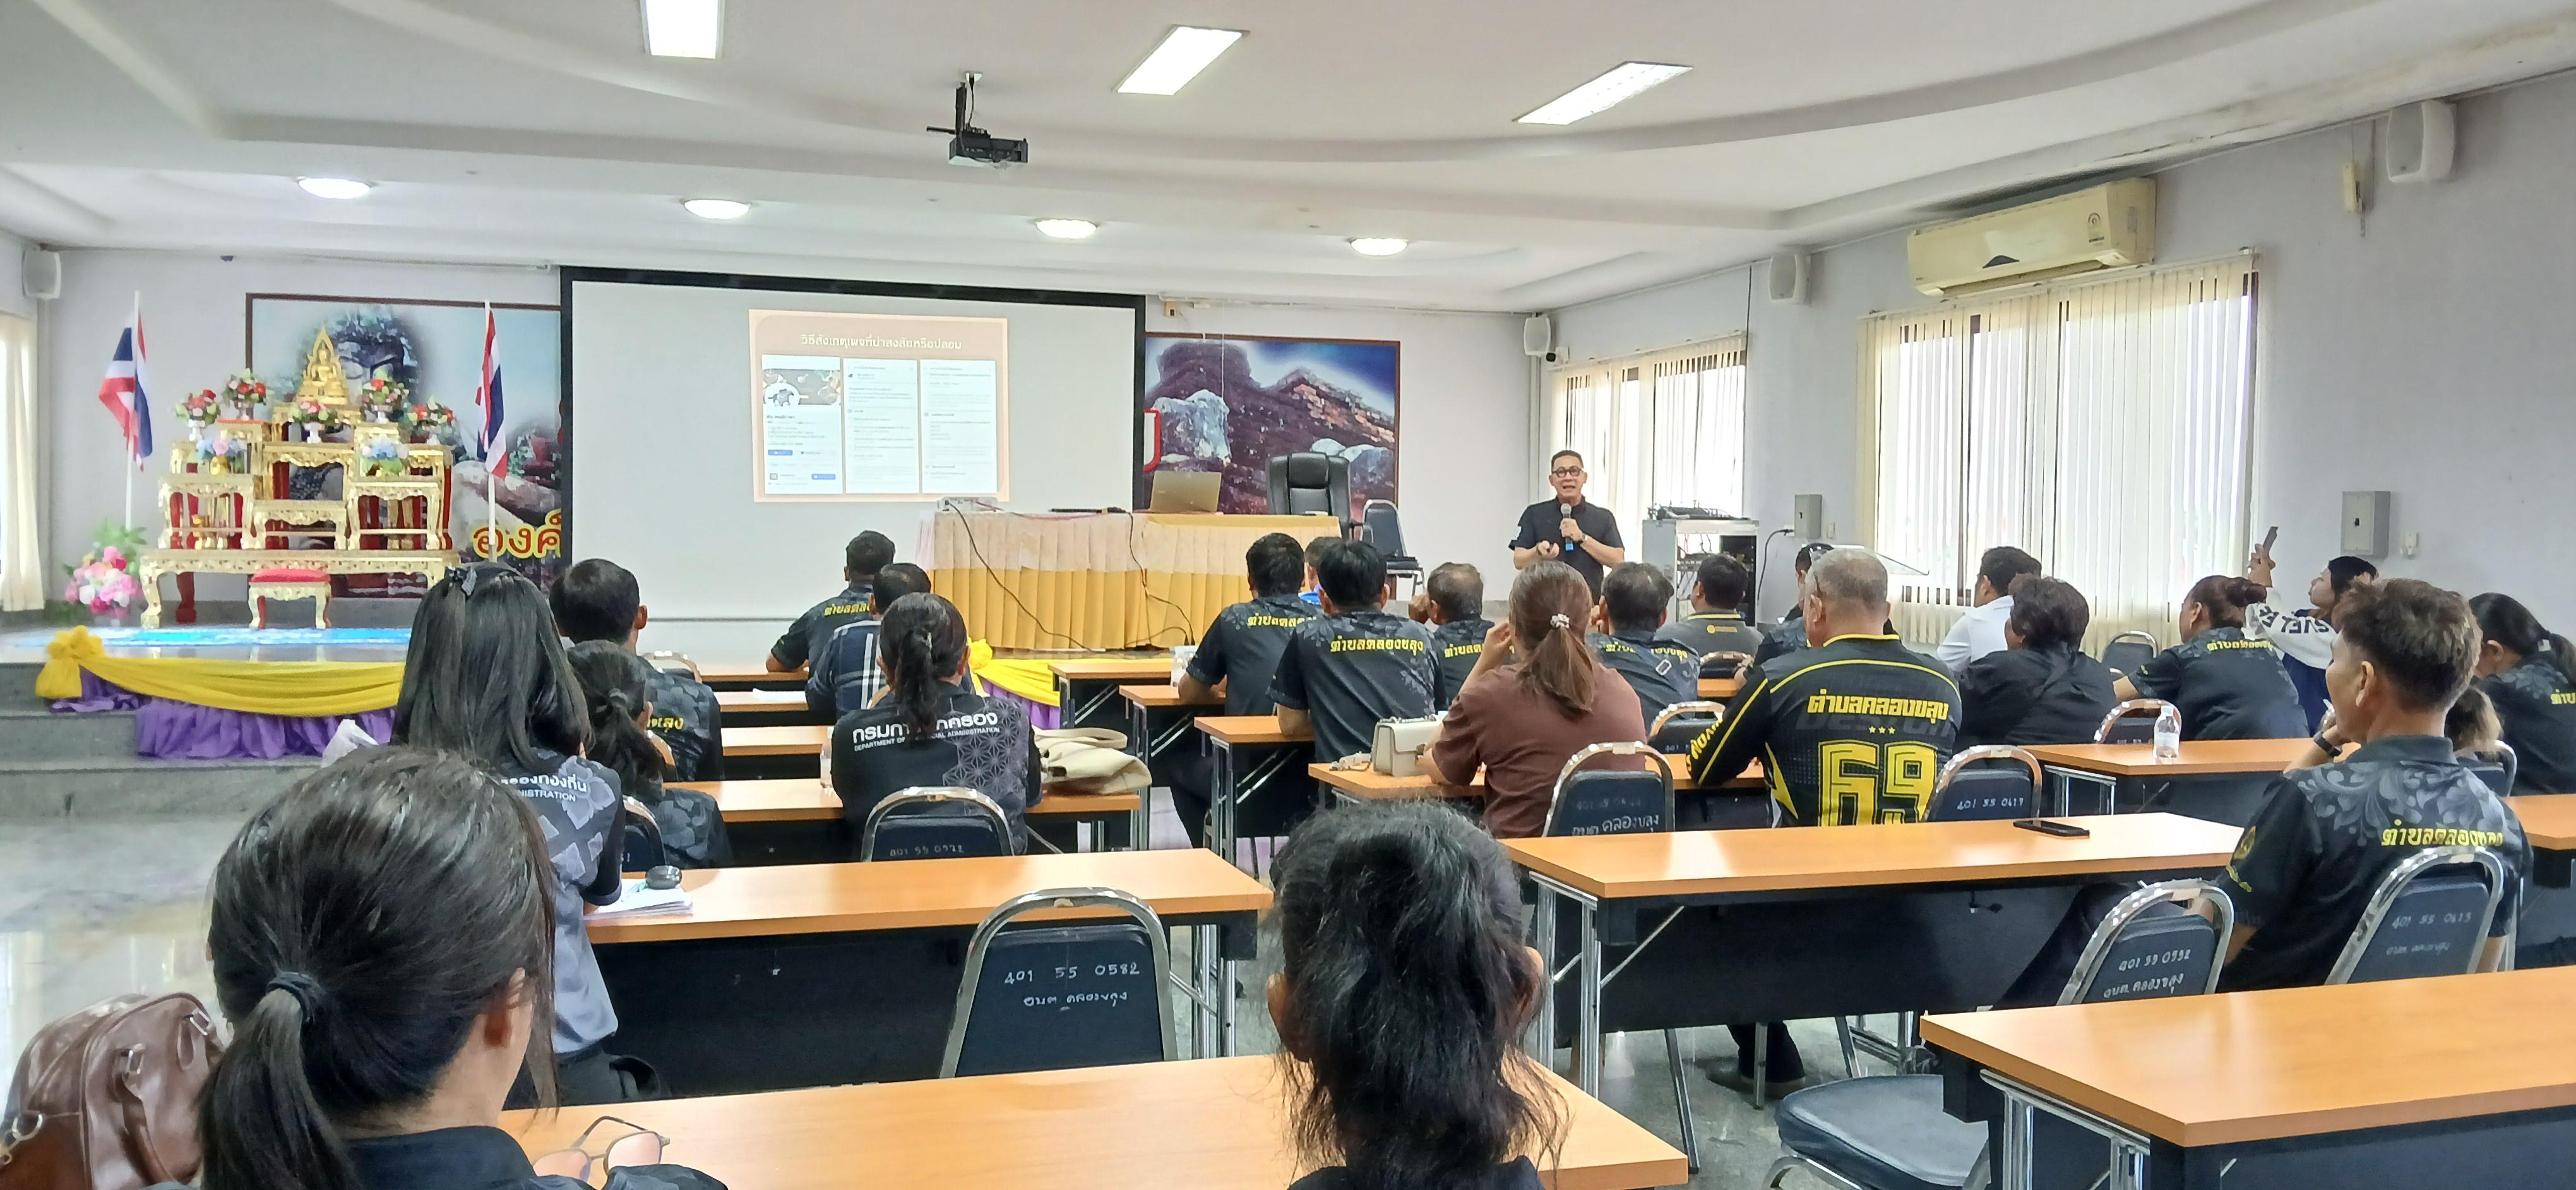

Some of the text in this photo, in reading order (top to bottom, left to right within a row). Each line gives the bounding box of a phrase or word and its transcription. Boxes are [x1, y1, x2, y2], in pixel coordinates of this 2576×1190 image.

[1330, 635, 1424, 656] ตำบลคลองขลุง
[1807, 688, 1949, 724] ตำบลคลองขลุง
[854, 739, 895, 752] DEPARTMENT
[947, 727, 1001, 738] ADMINISTRATION
[1818, 739, 1938, 827] 69
[1957, 798, 1976, 810] 401
[1005, 961, 1140, 985] 401 55 0582
